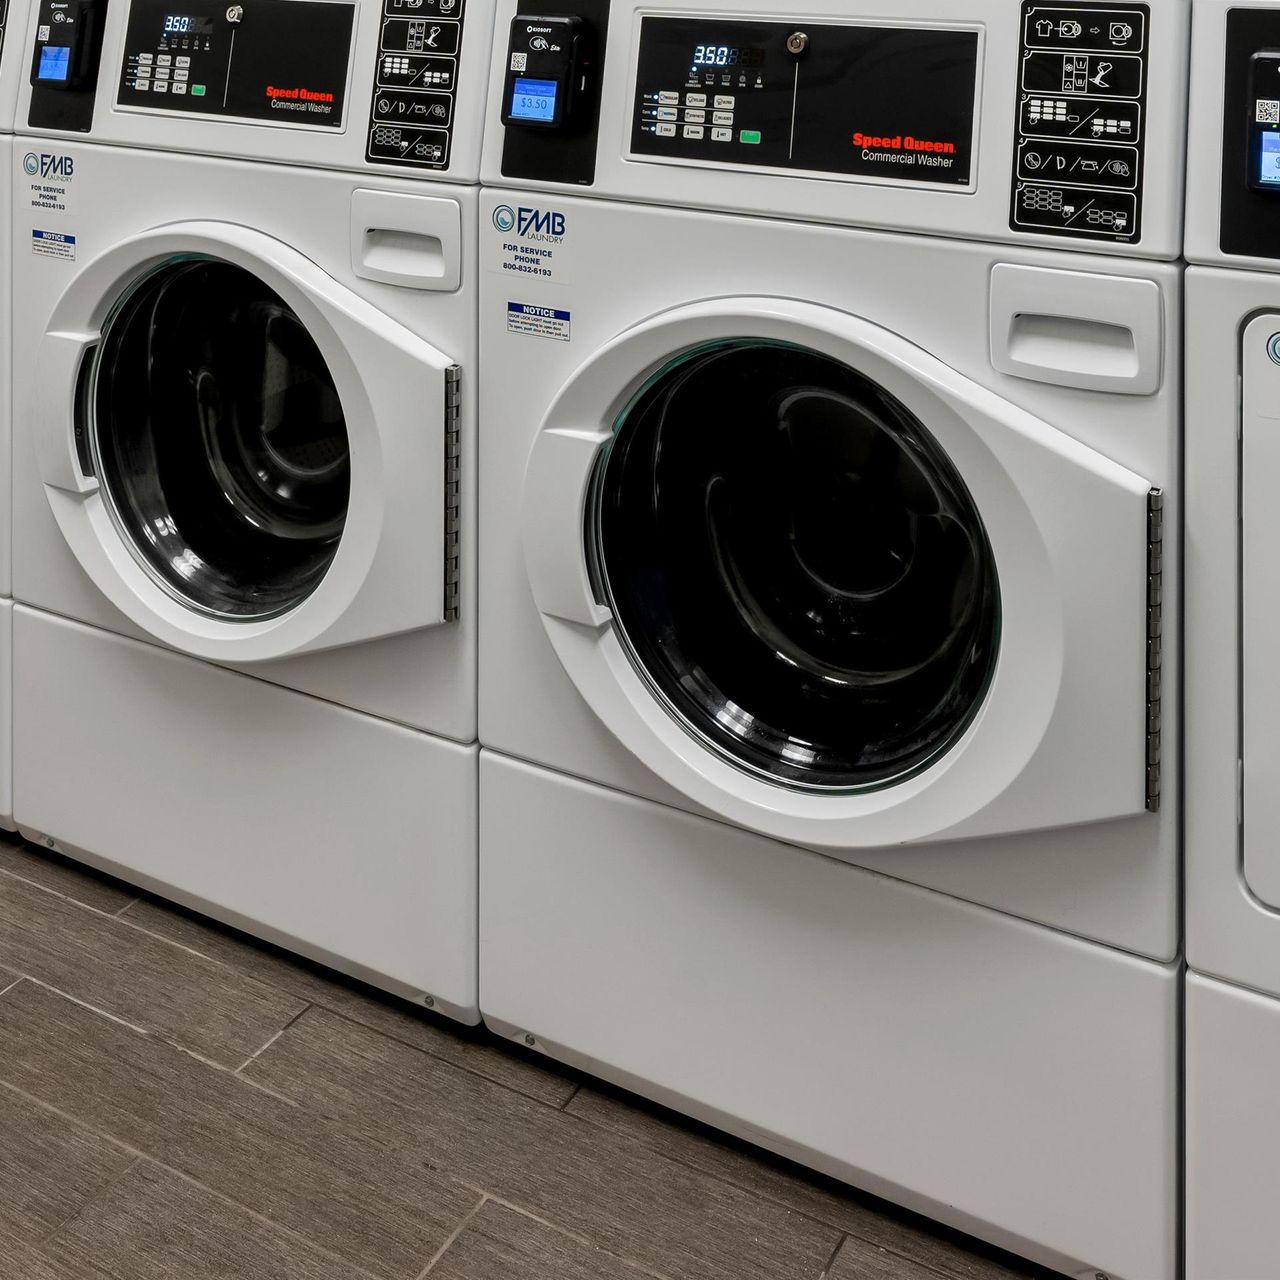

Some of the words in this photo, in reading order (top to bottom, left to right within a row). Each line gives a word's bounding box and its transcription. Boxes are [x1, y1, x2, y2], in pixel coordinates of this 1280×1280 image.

[266, 86, 299, 98] Speed
[300, 88, 334, 102] Queen
[271, 99, 307, 112] Commercial
[308, 102, 332, 114] Washer
[521, 97, 547, 110] $3.50
[852, 133, 901, 148] Speed
[903, 136, 955, 154] Queen
[40, 153, 74, 178] FMB
[861, 149, 916, 165] Commercial
[917, 154, 953, 168] Washer
[48, 174, 72, 182] LAUNDRY
[39, 193, 57, 201] PHONE
[42, 186, 65, 195] SERVICE
[517, 207, 566, 236] FMB
[42, 232, 65, 242] NOTICE
[527, 232, 564, 245] LAUNDRY
[503, 243, 518, 252] FOR
[520, 245, 553, 258] SERVICE
[514, 255, 541, 265] PHONE
[503, 262, 552, 277] 800-832-6193
[523, 305, 555, 318] NOTICE
